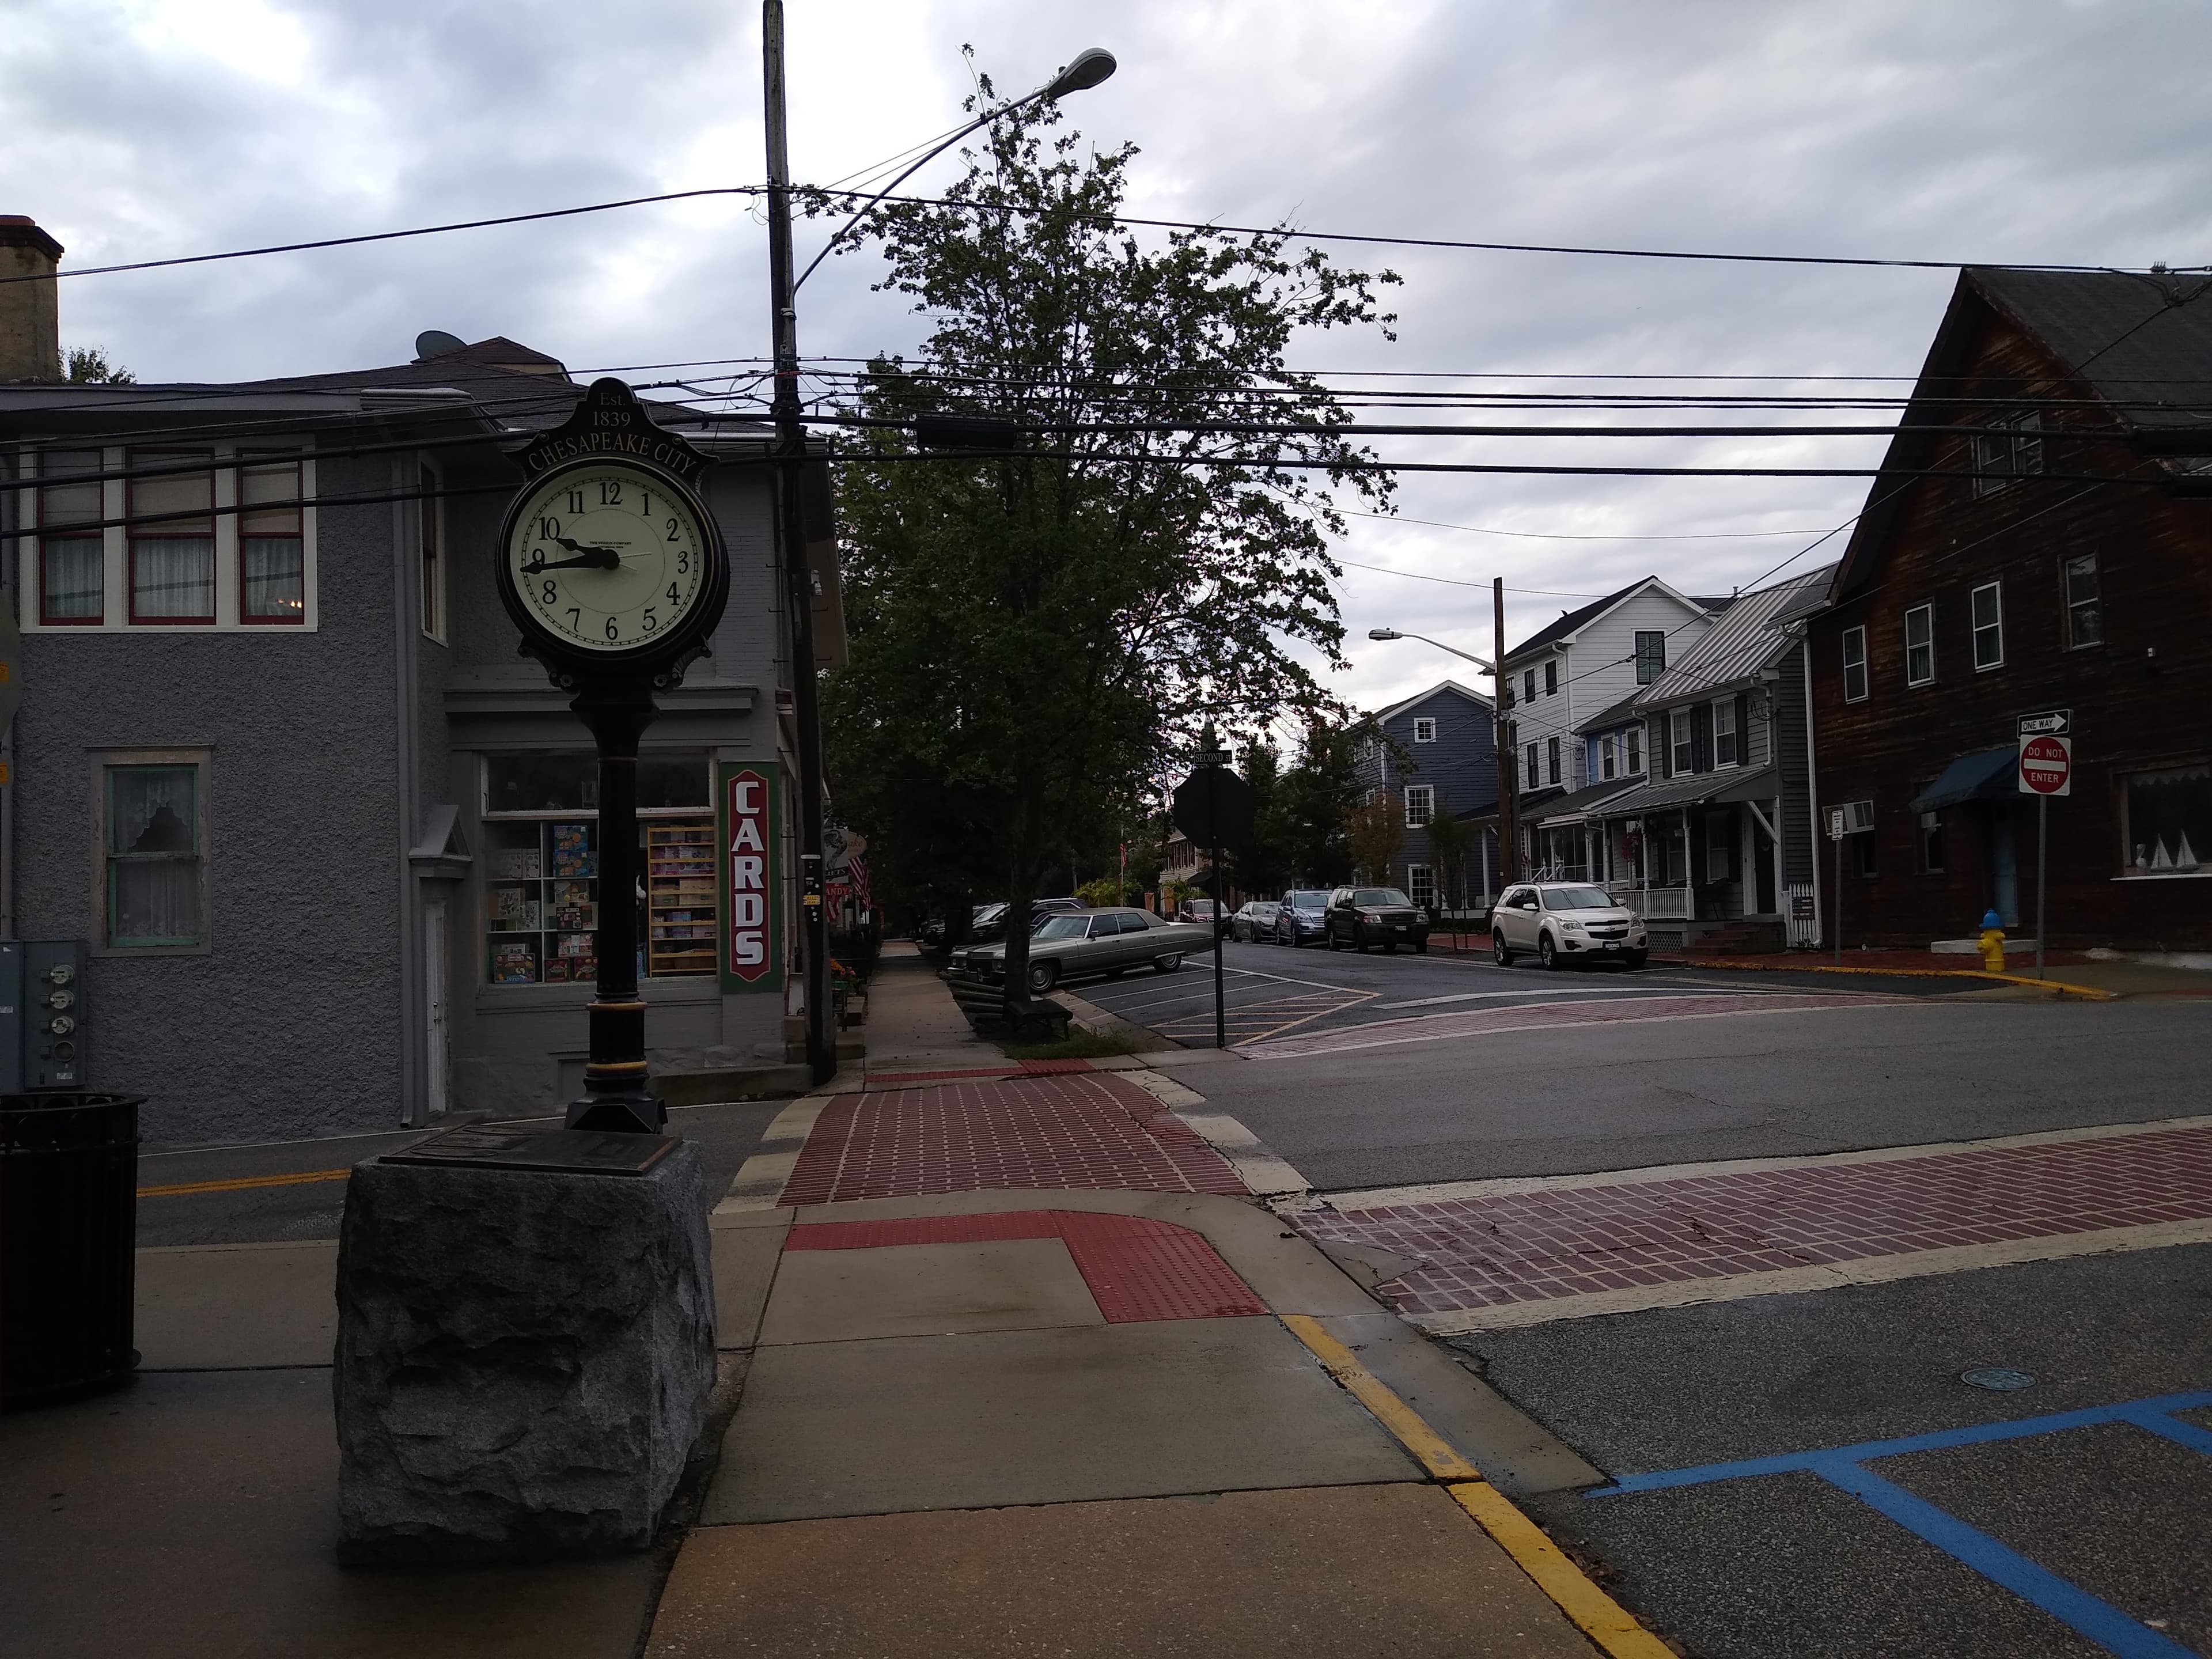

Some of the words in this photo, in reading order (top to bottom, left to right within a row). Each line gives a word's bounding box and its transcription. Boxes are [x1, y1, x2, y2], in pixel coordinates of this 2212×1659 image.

[600, 393, 626, 406] Est.
[592, 411, 631, 427] 1839
[528, 432, 652, 472] CHESAPEAKE
[654, 443, 696, 475] CITY
[566, 490, 586, 514] 11
[599, 482, 623, 505] 12
[641, 493, 651, 516] 1
[538, 516, 560, 540] 10
[666, 518, 681, 541] 2
[677, 551, 688, 574] 3
[543, 580, 557, 605] 8
[666, 581, 681, 605] 4
[565, 608, 581, 632] 7
[605, 616, 618, 640] 6
[642, 606, 657, 631] 5
[2022, 721, 2037, 730] ONE
[2039, 718, 2054, 728] WAY
[1195, 752, 1223, 762] SECOND
[2028, 747, 2040, 756] DO
[2046, 748, 2062, 758] NOT
[2031, 772, 2059, 783] ENTER
[730, 781, 765, 965] CARDS
